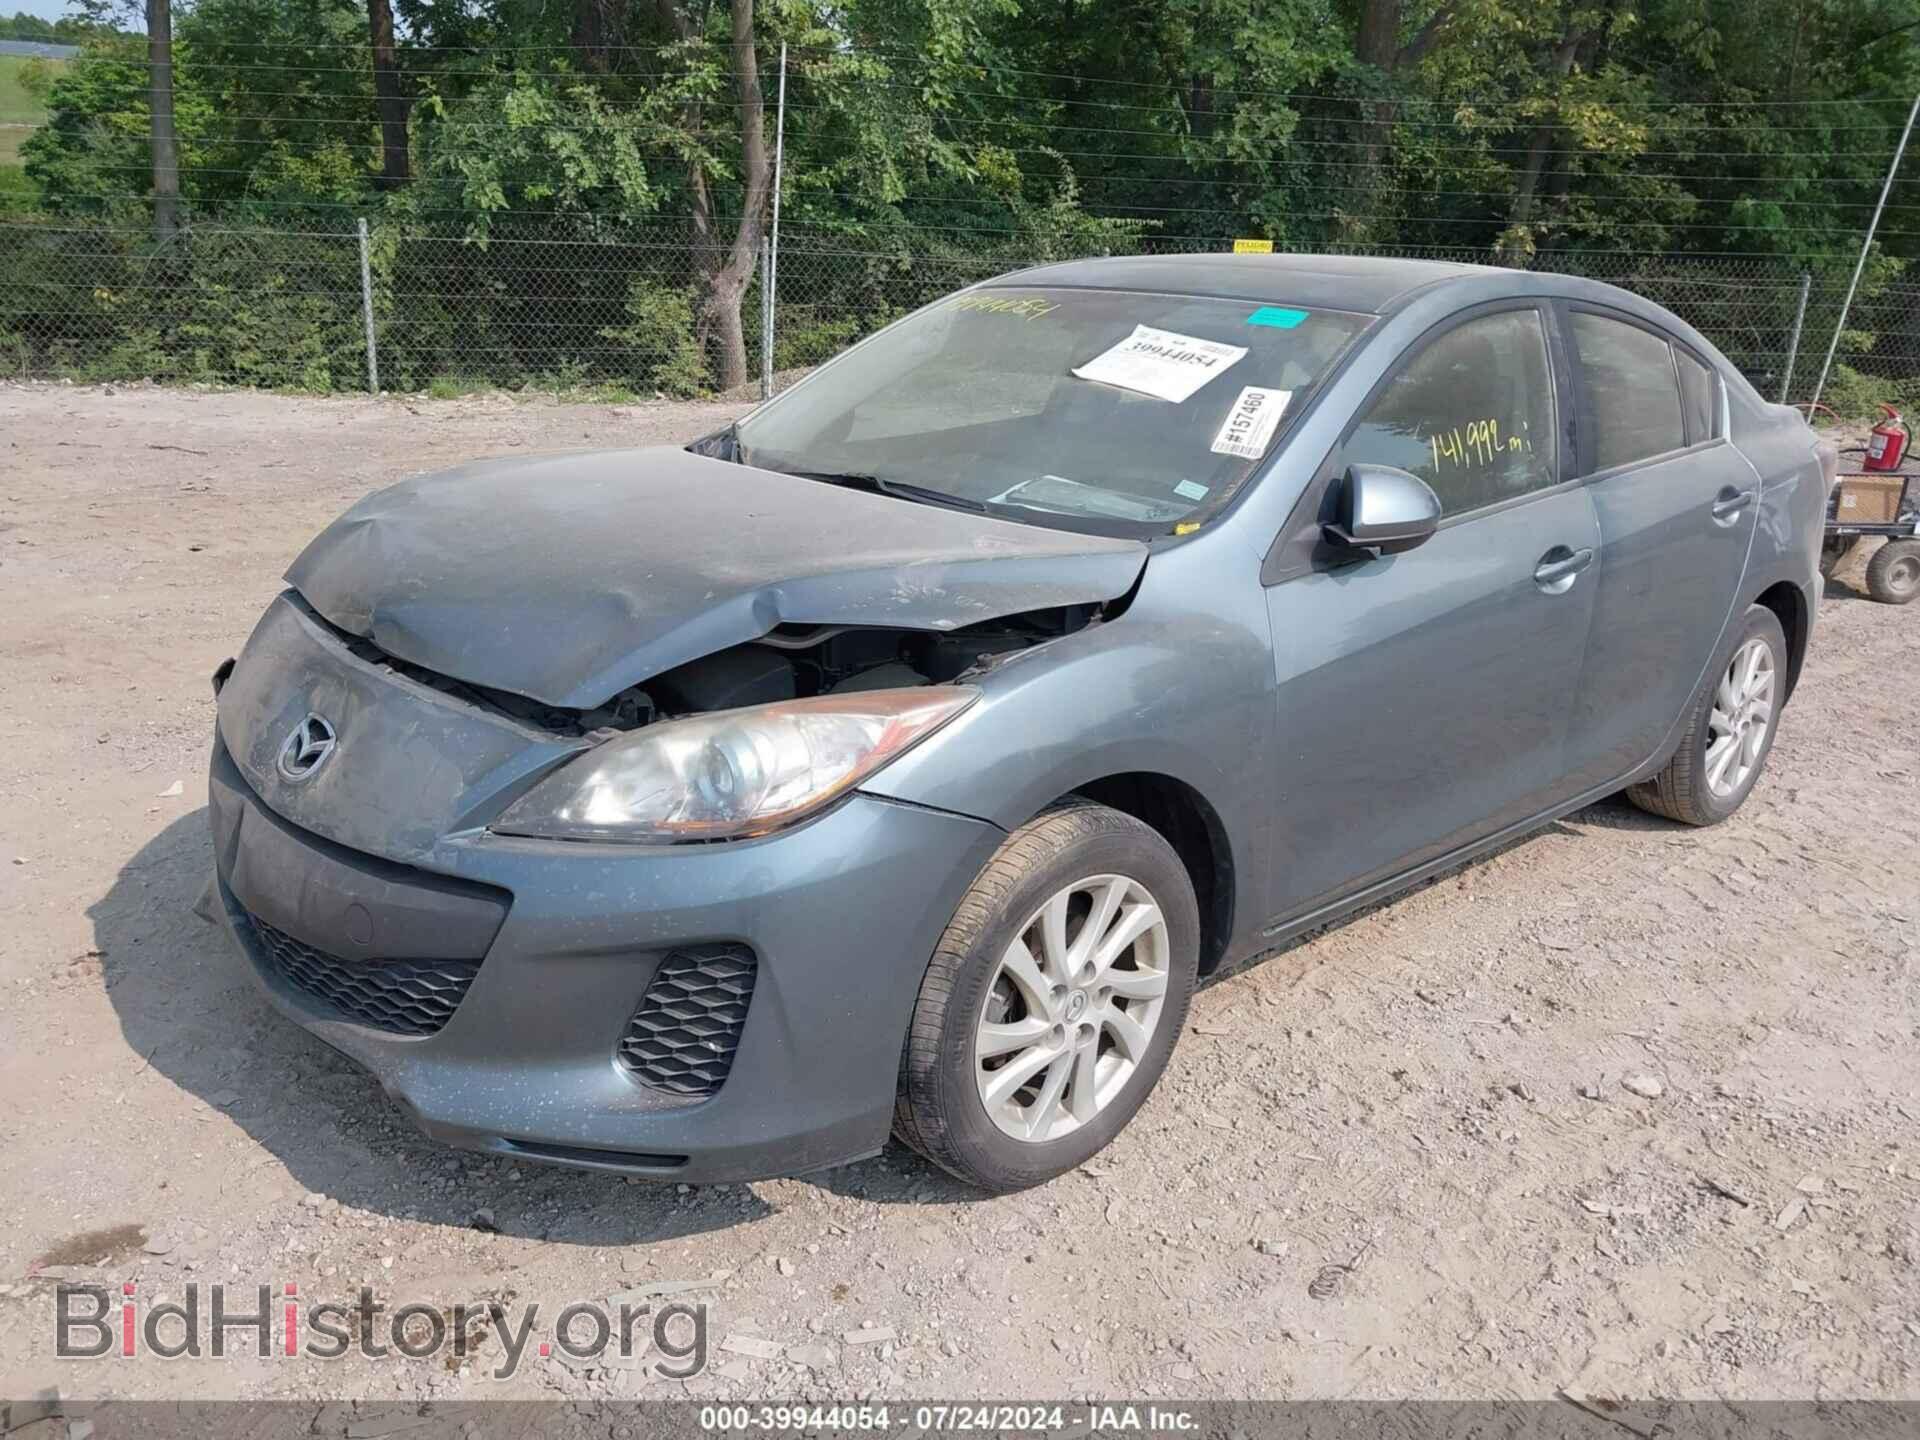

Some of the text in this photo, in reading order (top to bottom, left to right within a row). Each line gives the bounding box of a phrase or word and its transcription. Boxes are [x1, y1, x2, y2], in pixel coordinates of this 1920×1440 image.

[1124, 341, 1219, 368] 39944054
[1225, 392, 1266, 443] #157460
[1431, 418, 1505, 473] 141,992
